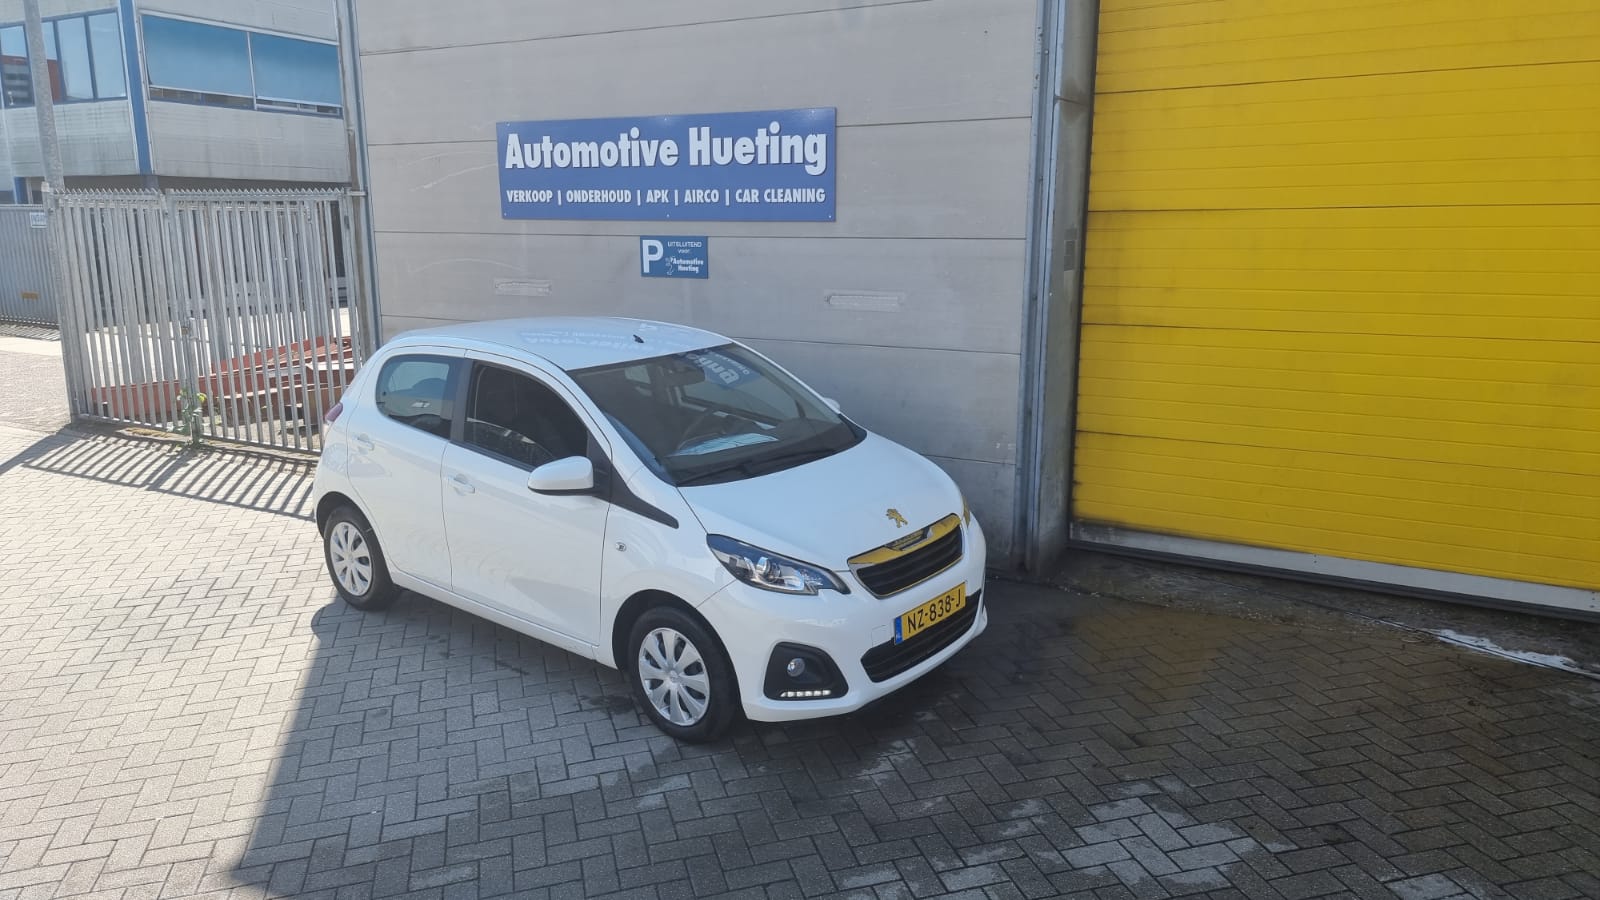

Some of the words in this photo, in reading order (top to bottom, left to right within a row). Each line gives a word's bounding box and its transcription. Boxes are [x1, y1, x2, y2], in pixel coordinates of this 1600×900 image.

[505, 127, 679, 169] Automotive
[688, 121, 828, 176] Hueting
[506, 190, 553, 203] VERKOOP
[566, 189, 632, 203] ONDERHOUD
[646, 189, 669, 203] APK
[684, 189, 719, 203] AIRCO
[735, 188, 760, 203] CAR
[764, 188, 826, 203] CLEANING
[642, 239, 664, 273] P
[672, 257, 704, 265] Automotive
[677, 265, 699, 274] Hueting
[907, 588, 961, 634] NZ-838-J
